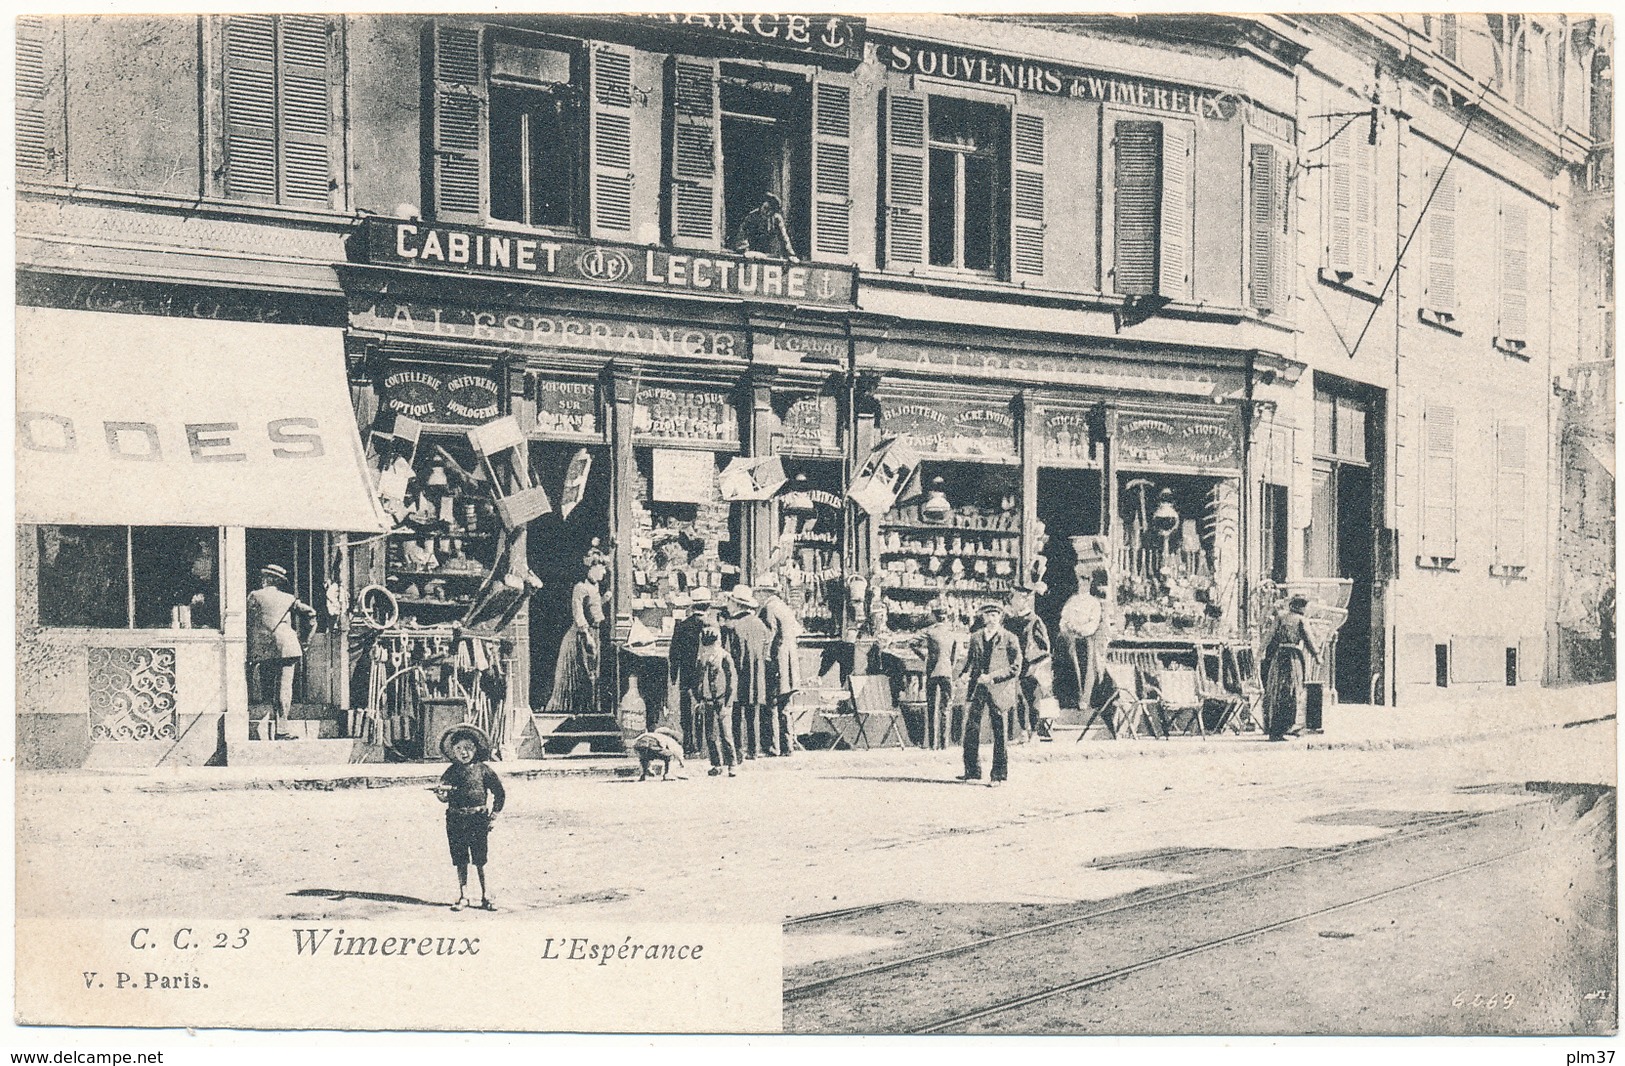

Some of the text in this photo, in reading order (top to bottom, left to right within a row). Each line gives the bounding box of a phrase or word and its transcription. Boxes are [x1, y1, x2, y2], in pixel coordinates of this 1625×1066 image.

[891, 45, 1227, 119] SOUVENIRS de WIMEREUX
[396, 224, 806, 297] CABINET de LECTURE
[391, 304, 735, 357] A L'ESPERANCE
[384, 371, 442, 390] COUTELLERIE
[389, 398, 436, 417] OPTIQUE
[446, 399, 500, 419] HORLOGERIE
[558, 400, 580, 410] SUR
[882, 404, 947, 425] BIJOUTERIE
